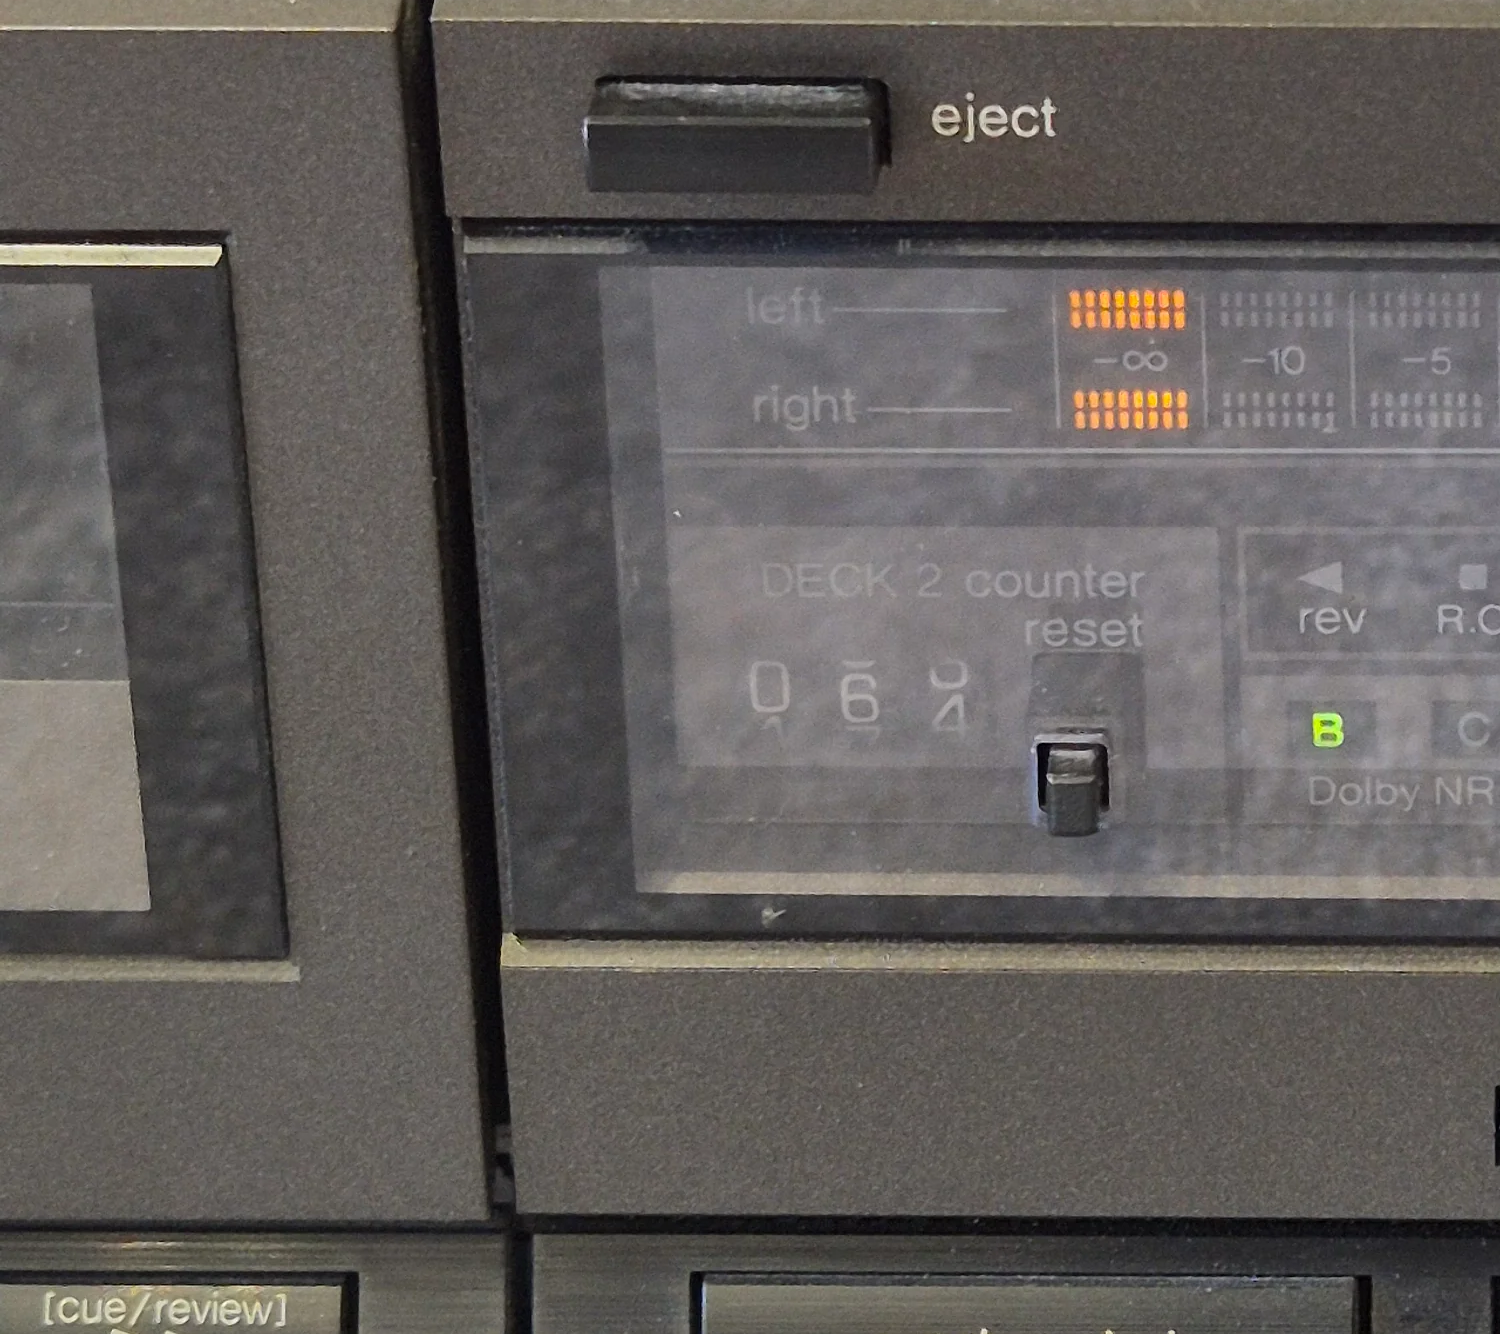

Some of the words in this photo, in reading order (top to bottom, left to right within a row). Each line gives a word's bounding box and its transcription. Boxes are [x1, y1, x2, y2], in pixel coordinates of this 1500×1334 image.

[931, 92, 1058, 143] eject
[746, 287, 826, 325] left
[753, 387, 857, 432] right
[762, 565, 897, 600] DECK
[916, 565, 944, 598] 2
[964, 565, 1146, 601] counter
[1025, 615, 1144, 648] reset
[1299, 607, 1367, 635] rev
[1312, 714, 1343, 747] B
[1458, 714, 1490, 747] C
[1309, 776, 1420, 813] Dolby
[1435, 778, 1493, 806] NR
[42, 1291, 287, 1328] [cue/review]
